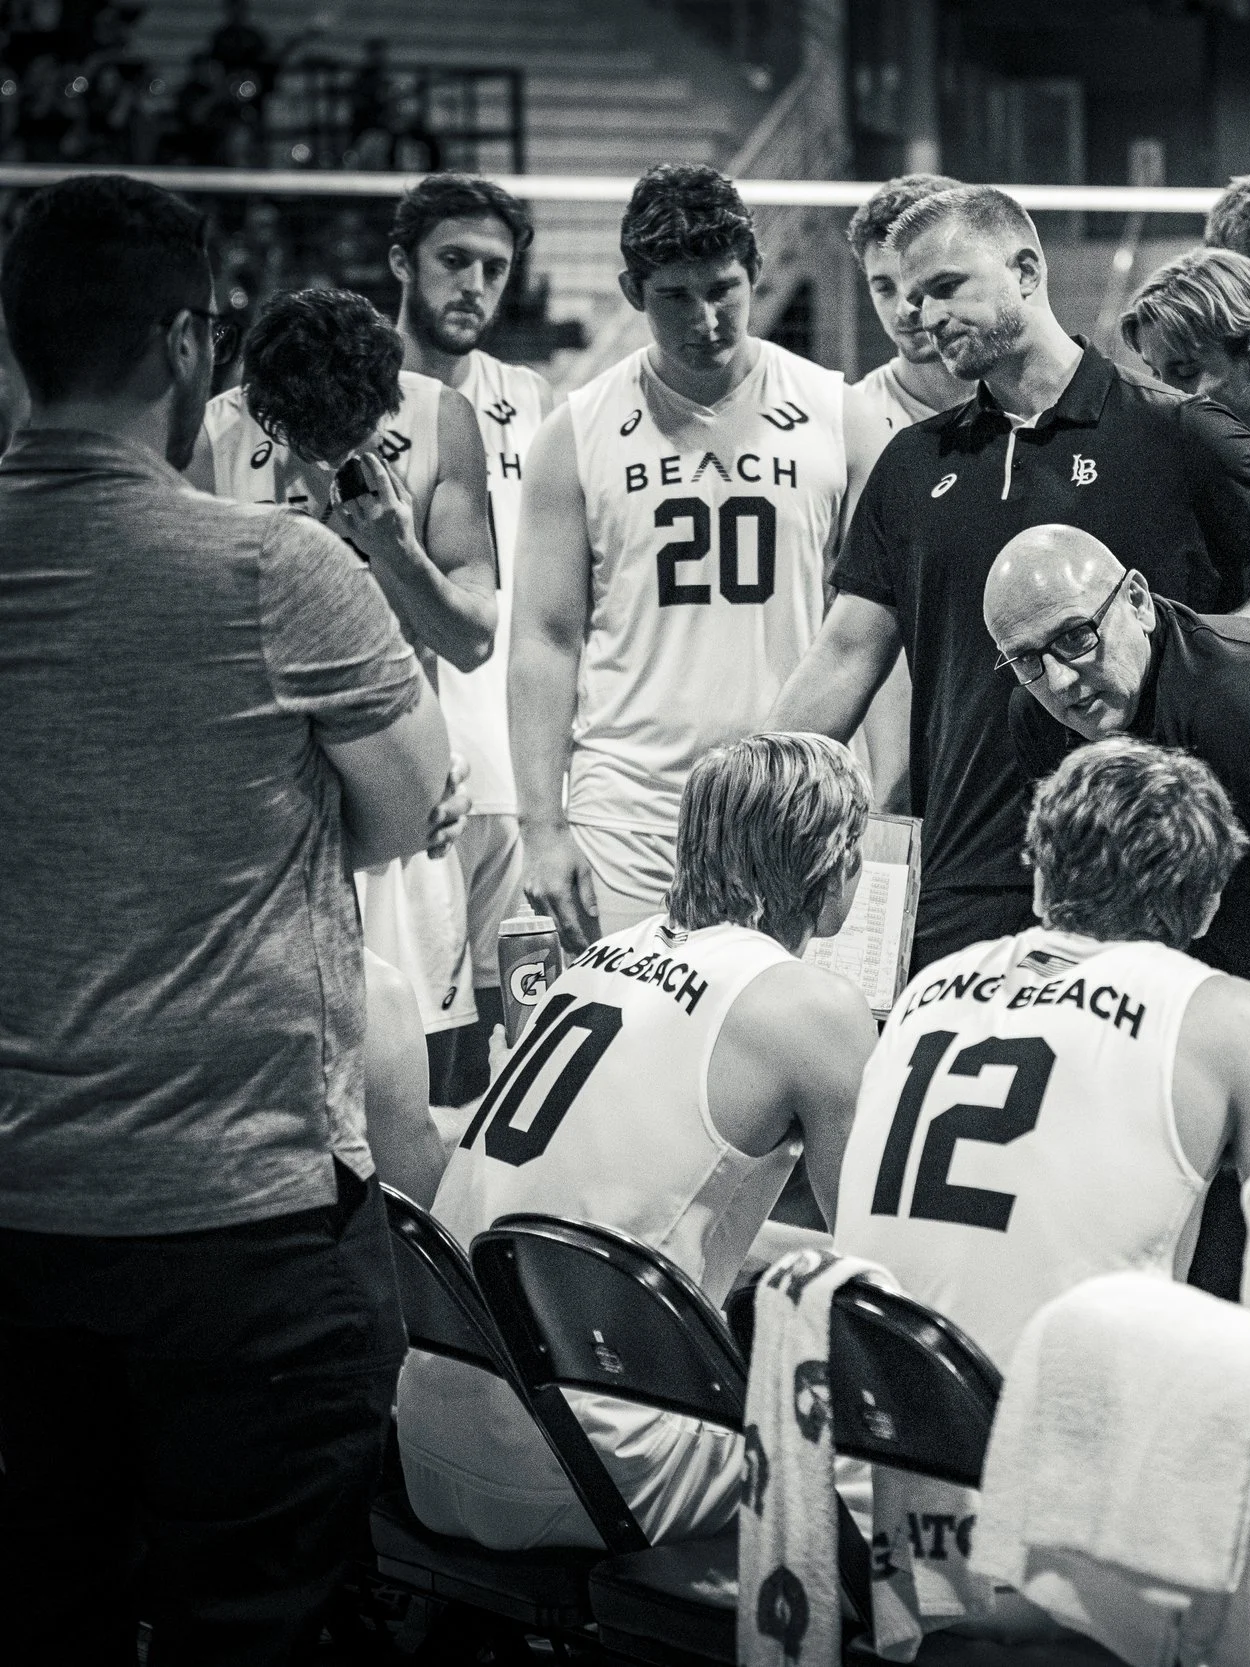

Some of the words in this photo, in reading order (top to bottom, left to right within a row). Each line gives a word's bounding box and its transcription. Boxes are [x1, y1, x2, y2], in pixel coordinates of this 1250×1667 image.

[625, 451, 797, 494] BEACH
[654, 496, 777, 608] 20
[510, 961, 548, 1007] G
[619, 952, 708, 1016] BEACH
[900, 971, 1006, 1026] LONG
[1006, 978, 1146, 1039] BEACH
[459, 993, 623, 1168] 10
[870, 1030, 1057, 1233] 12
